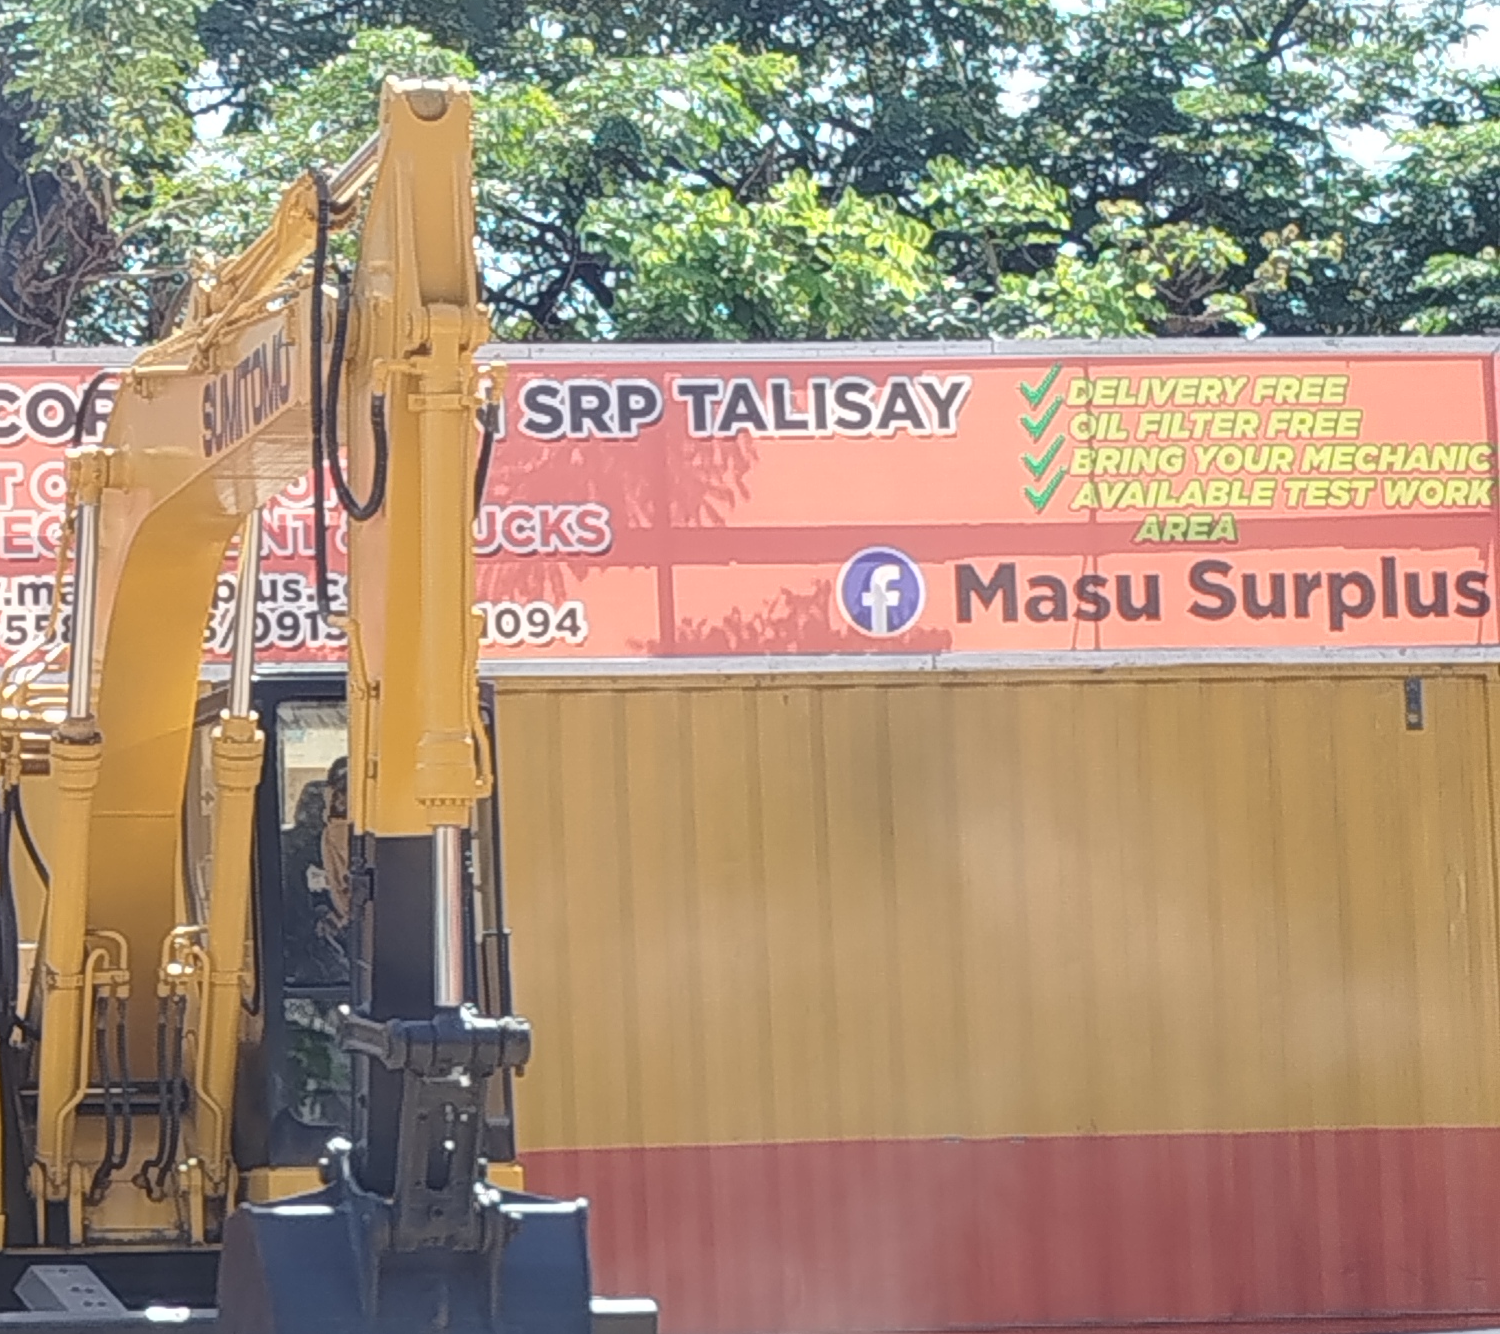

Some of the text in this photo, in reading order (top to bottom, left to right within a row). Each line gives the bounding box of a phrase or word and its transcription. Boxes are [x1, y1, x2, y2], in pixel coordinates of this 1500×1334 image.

[1067, 375, 1348, 407] DELIVERY FREE
[523, 382, 660, 436] SRP
[677, 380, 965, 435] TALISAY
[1069, 410, 1362, 442] OIL FILTER FREE
[1071, 443, 1495, 476] BRING YOUR MECHANIC
[1071, 477, 1495, 510] AVAILABLE TEST WORK
[473, 507, 607, 549] UCKS
[1134, 514, 1239, 544] AREA
[954, 556, 1491, 632] Masu Surplus
